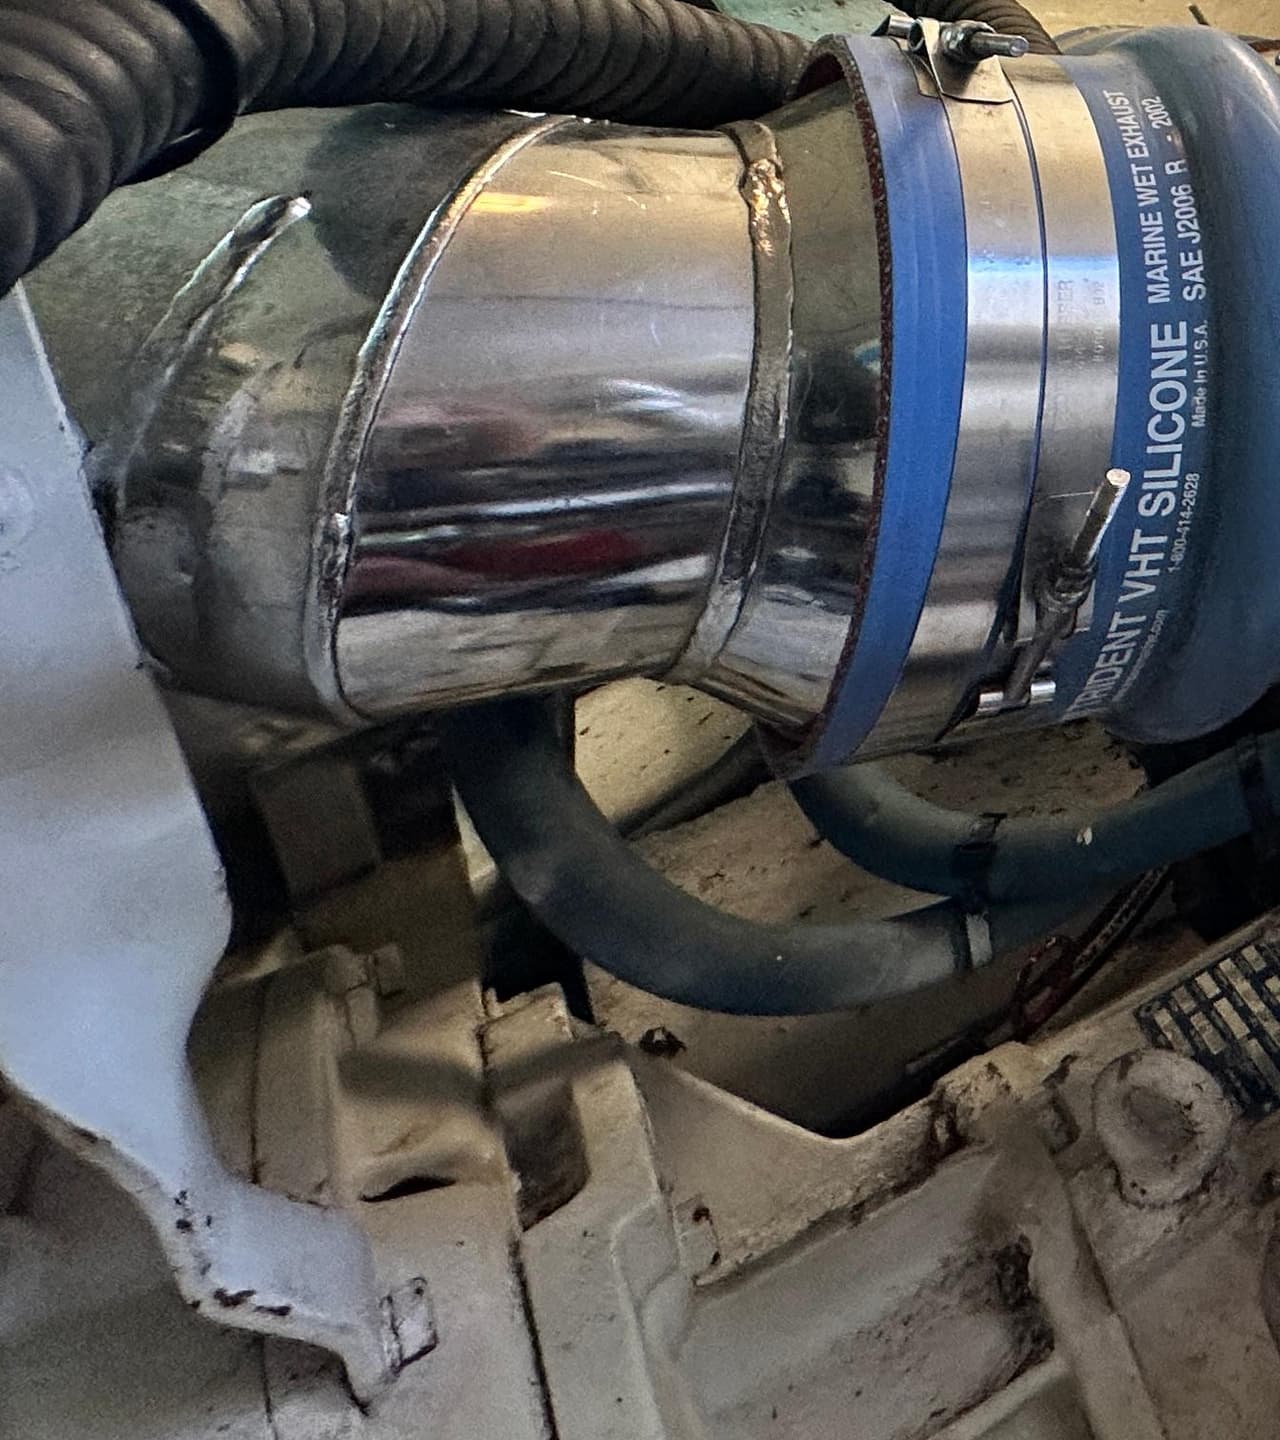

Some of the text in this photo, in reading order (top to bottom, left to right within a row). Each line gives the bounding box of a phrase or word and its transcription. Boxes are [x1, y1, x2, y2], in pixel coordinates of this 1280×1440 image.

[1141, 95, 1172, 129] 2002
[1103, 90, 1171, 303] MARINE WET EXHAUST
[1165, 159, 1188, 175] R
[1171, 183, 1201, 244] J2006
[1180, 250, 1207, 301] SAE
[1193, 320, 1209, 366] U.S.A.
[1138, 320, 1188, 517] SILICONE
[1191, 387, 1207, 427] Made
[1167, 472, 1200, 573] 1-800-414-2628
[1118, 528, 1168, 603] VHT
[1063, 611, 1147, 722] TRIDENT
